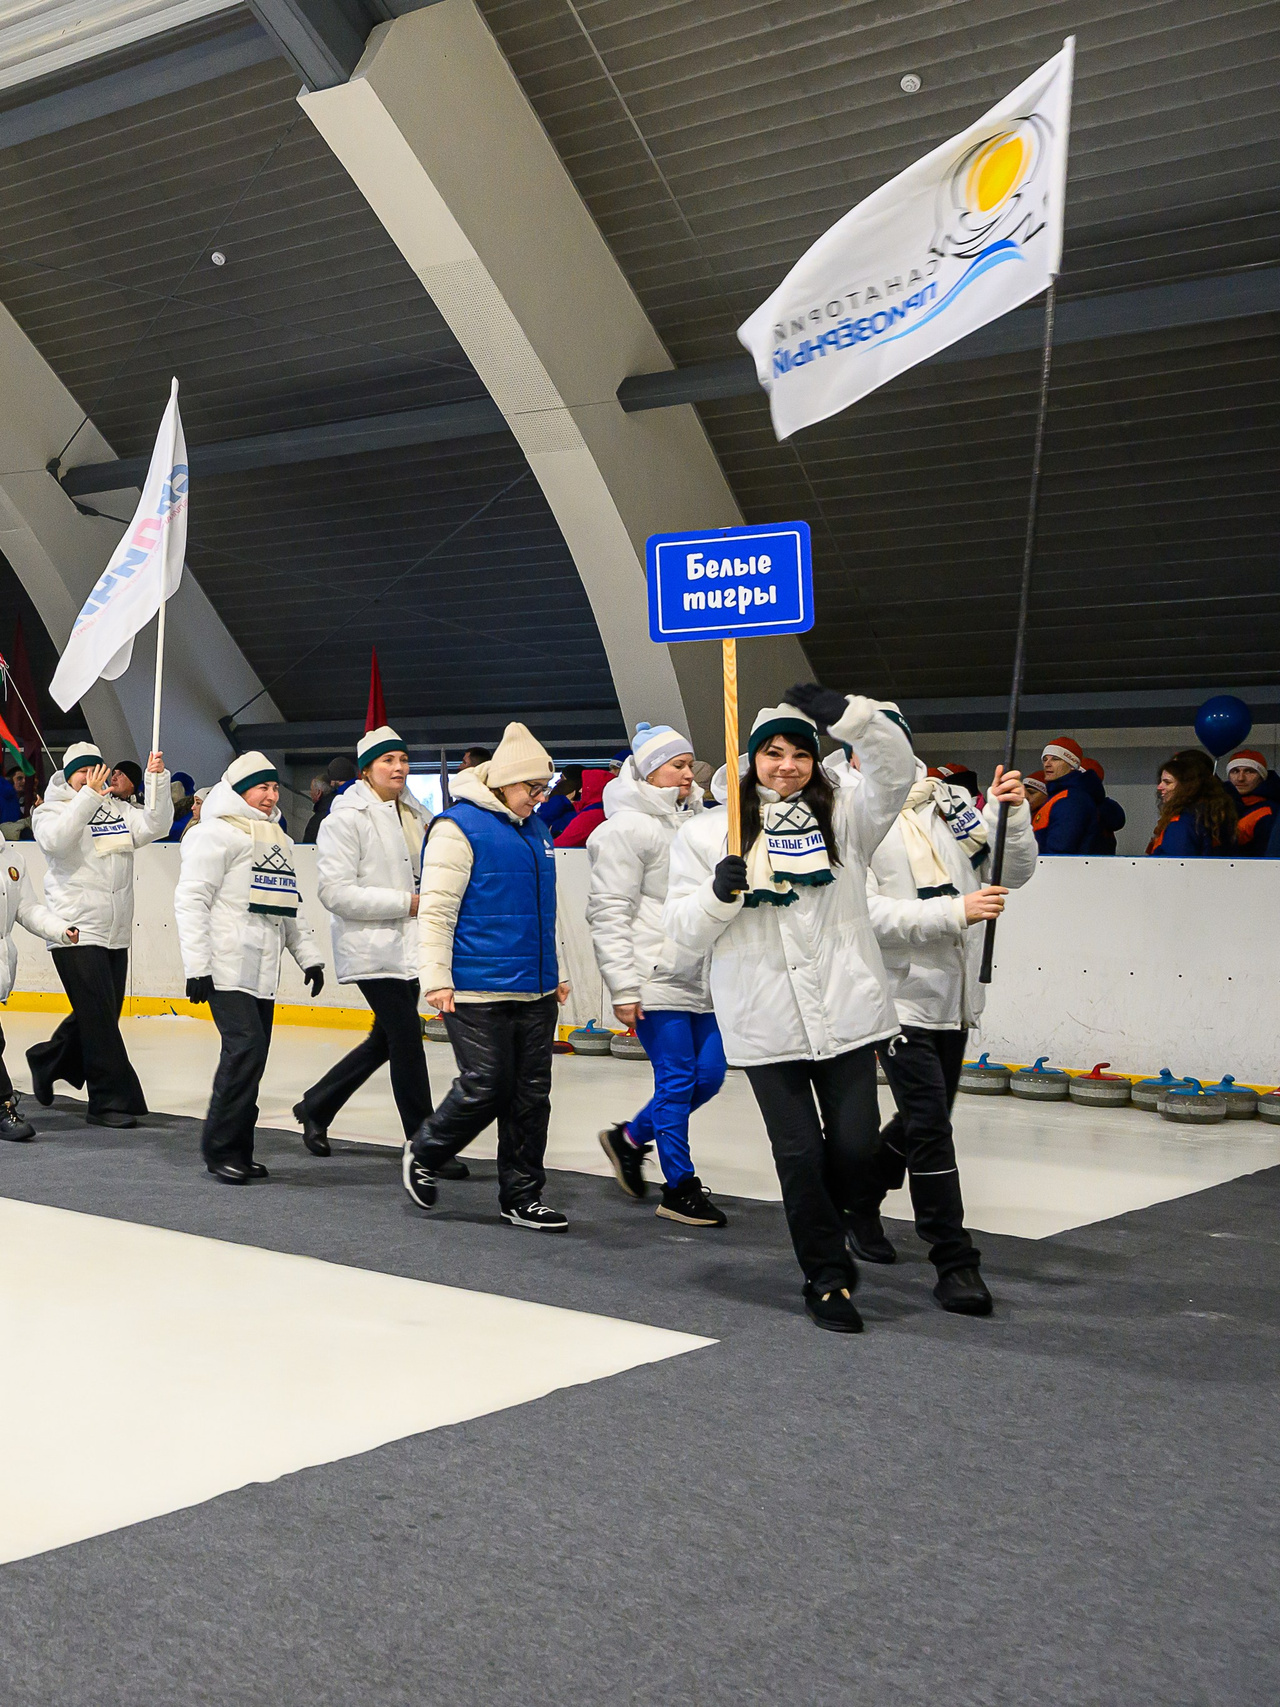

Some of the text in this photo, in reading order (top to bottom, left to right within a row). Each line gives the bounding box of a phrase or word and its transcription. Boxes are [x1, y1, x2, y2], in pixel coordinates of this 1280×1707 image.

[686, 552, 772, 581] Белые
[682, 585, 777, 615] тигры
[768, 833, 823, 850] БЕЛЫЕ ТИГ
[254, 874, 278, 886] БЕЛЫЕ
